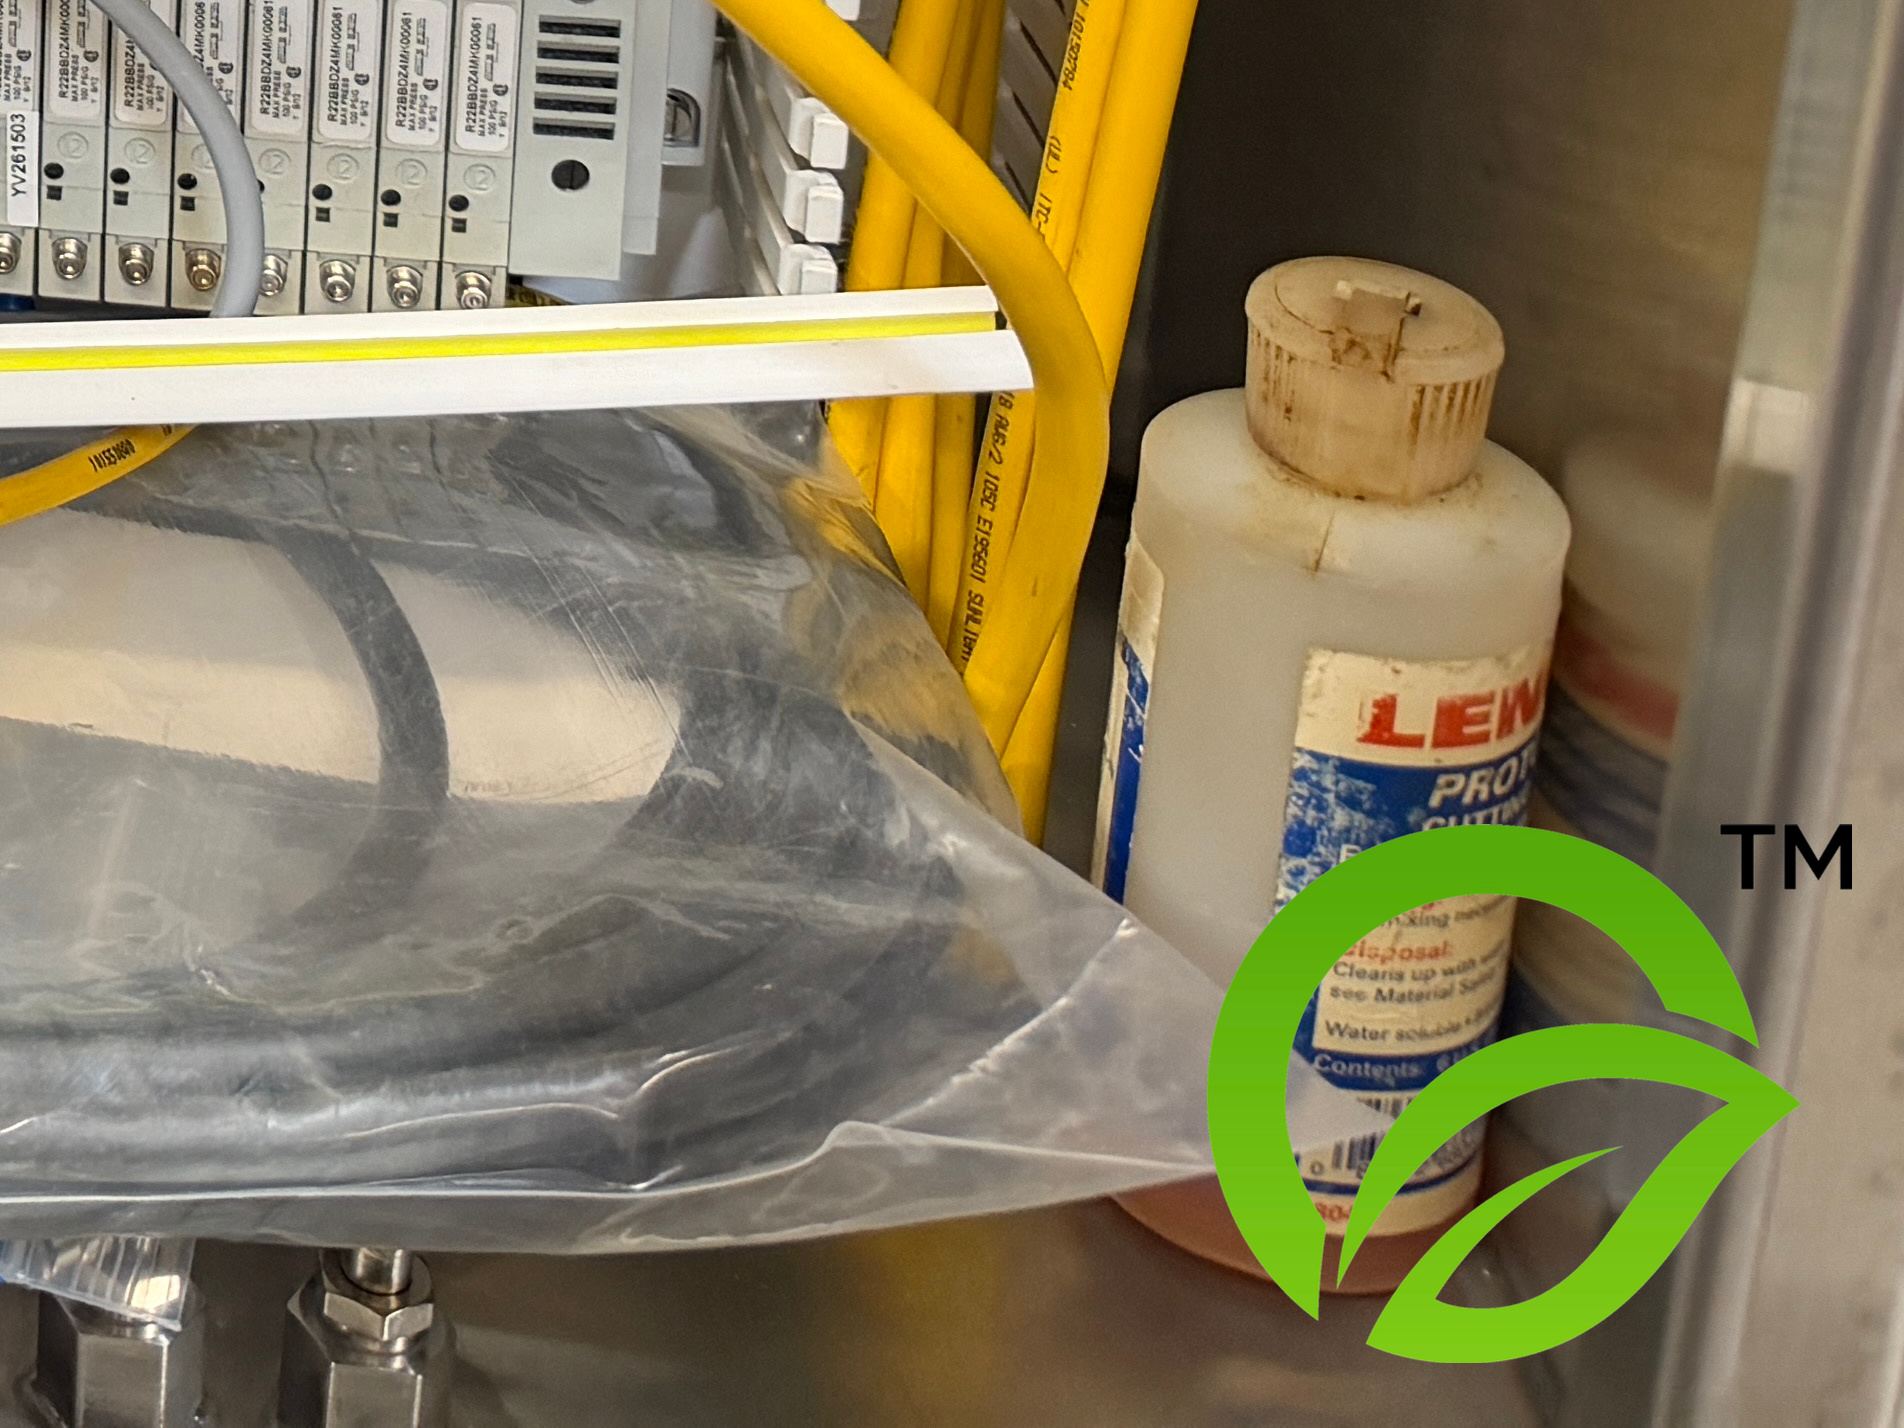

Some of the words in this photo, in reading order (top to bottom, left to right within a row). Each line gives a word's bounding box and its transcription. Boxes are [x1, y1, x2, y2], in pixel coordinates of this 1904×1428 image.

[11, 113, 26, 196] YV261503
[969, 517, 993, 583] E195601
[1332, 960, 1405, 983] Cleans
[1373, 981, 1455, 1003] Material
[1324, 1020, 1390, 1042] Water
